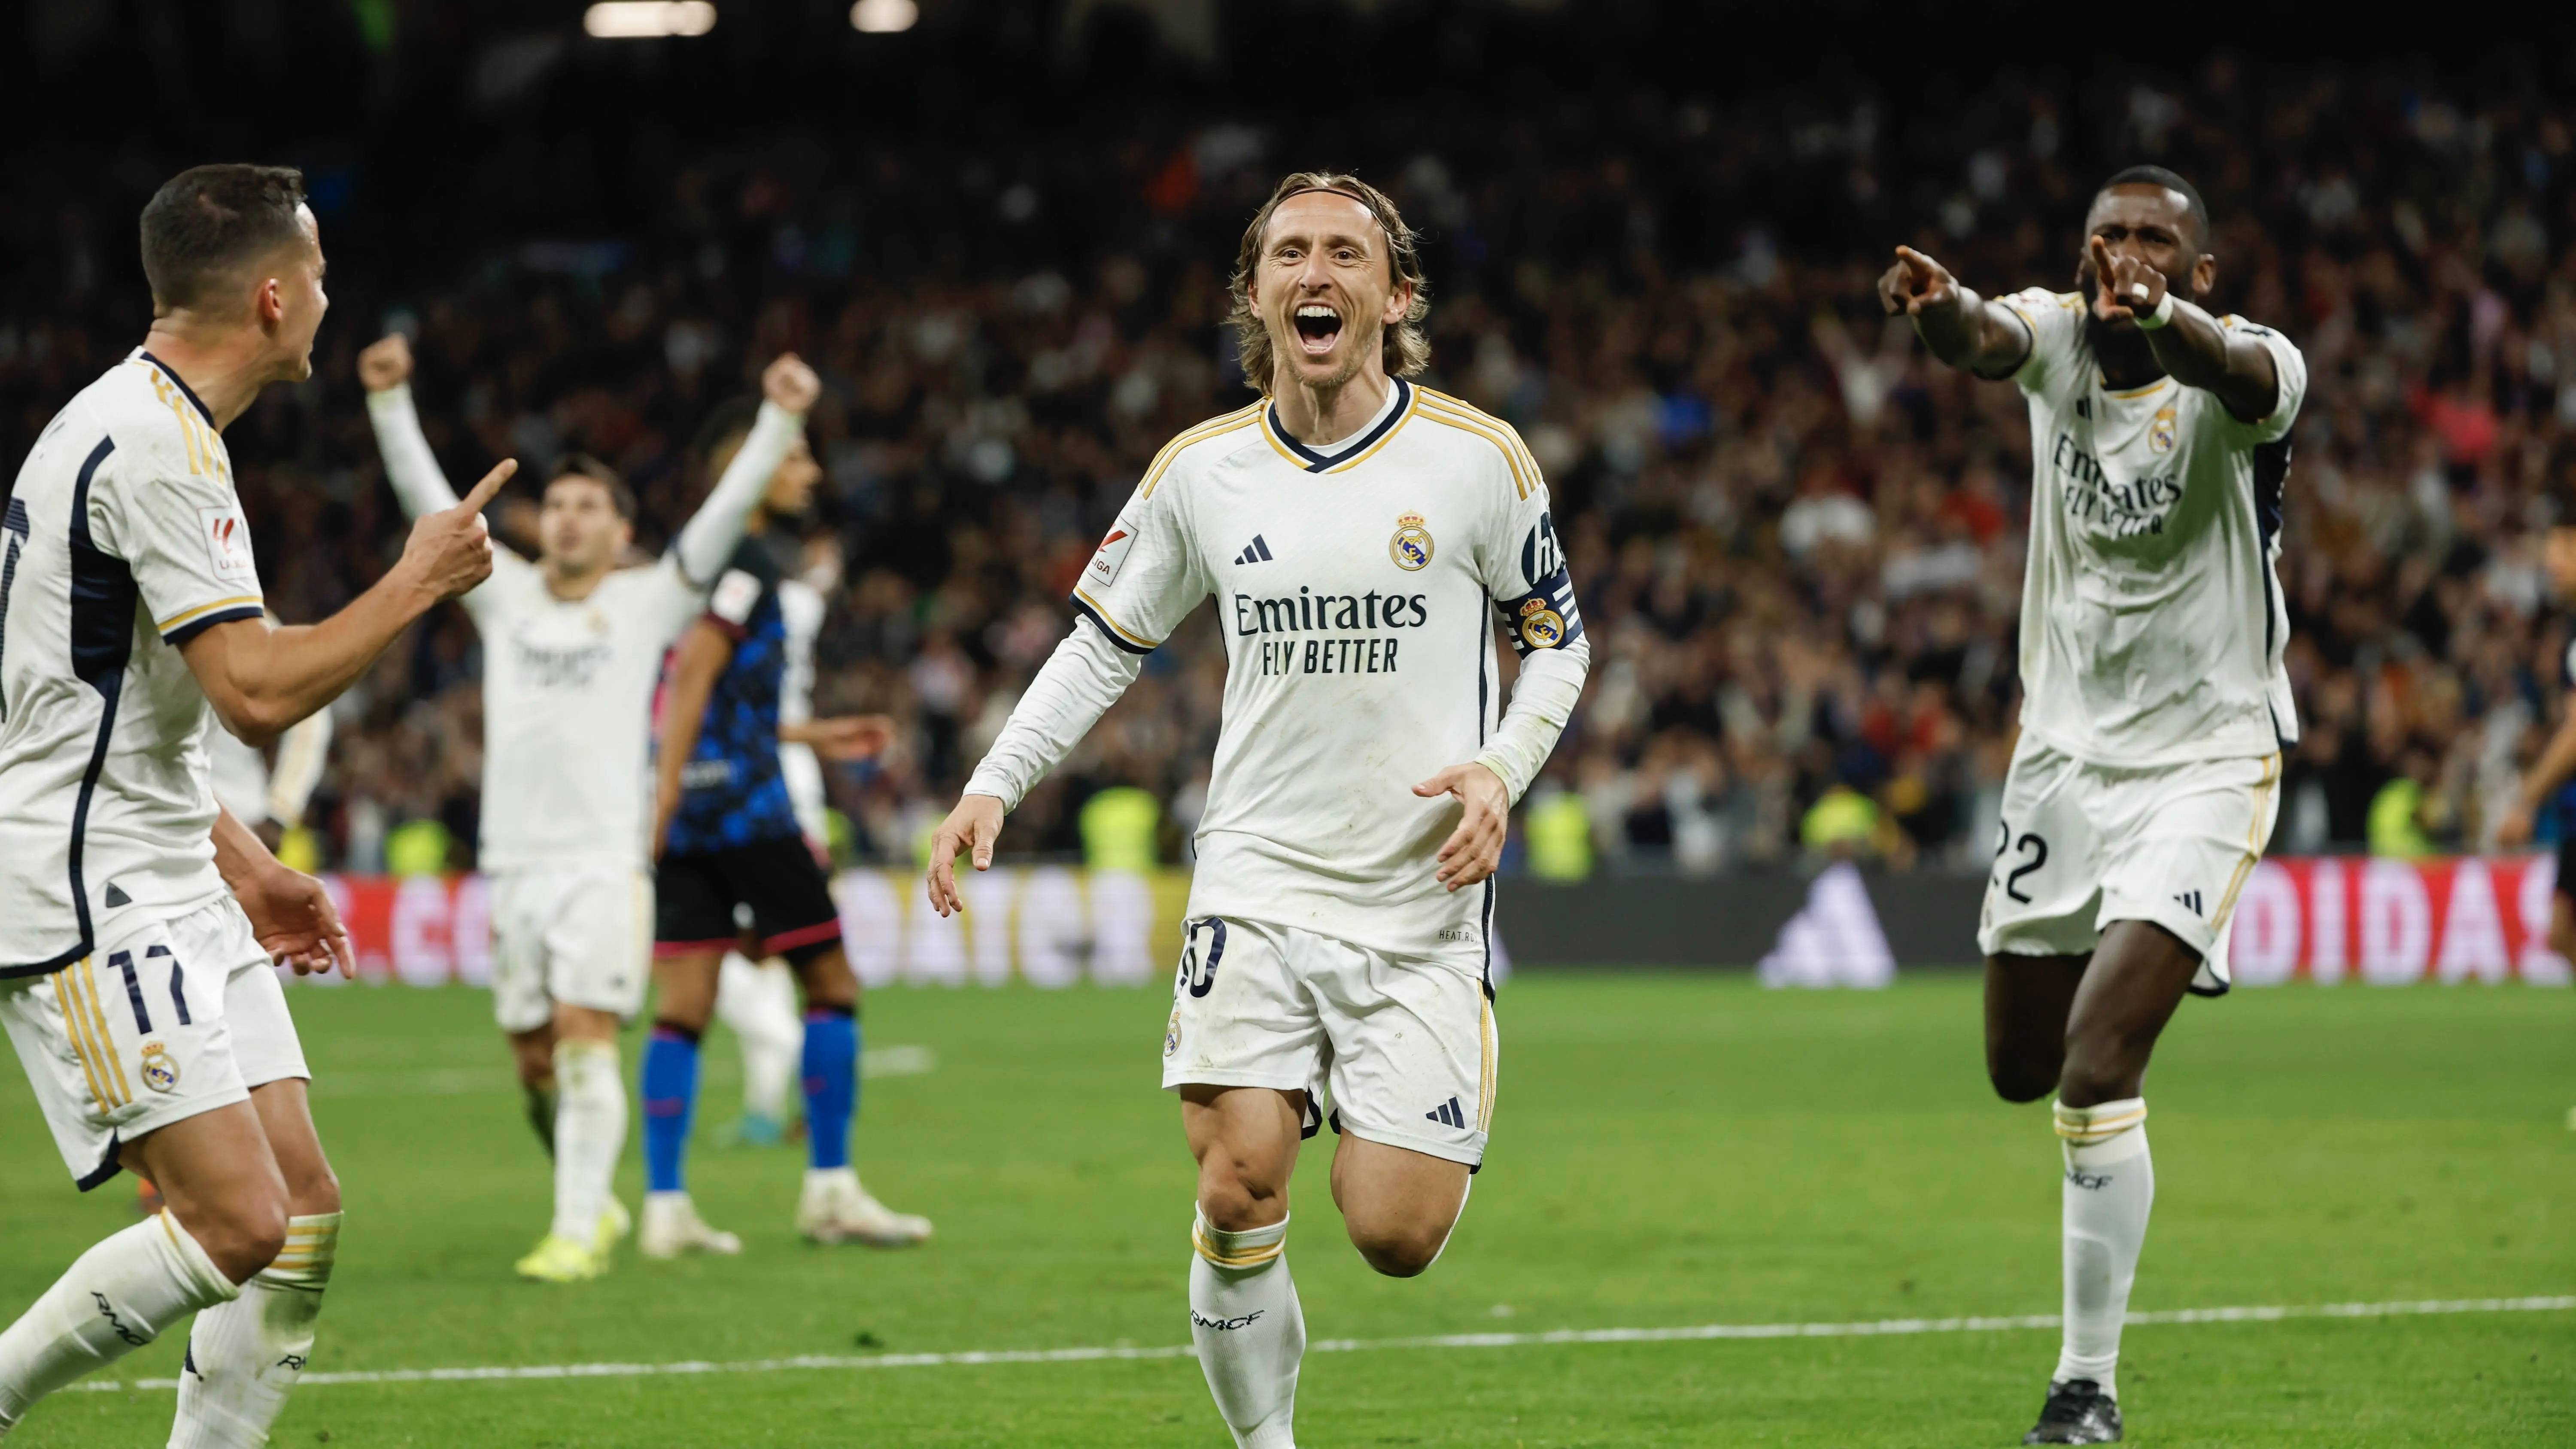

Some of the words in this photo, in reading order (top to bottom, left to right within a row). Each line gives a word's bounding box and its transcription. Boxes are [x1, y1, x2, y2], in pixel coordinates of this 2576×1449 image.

[1235, 585, 1427, 636] Emirates
[1263, 641, 1296, 676] FLY
[1303, 638, 1398, 674] BETTER
[107, 945, 191, 1035] 17
[1191, 1309, 1265, 1331] RMCF
